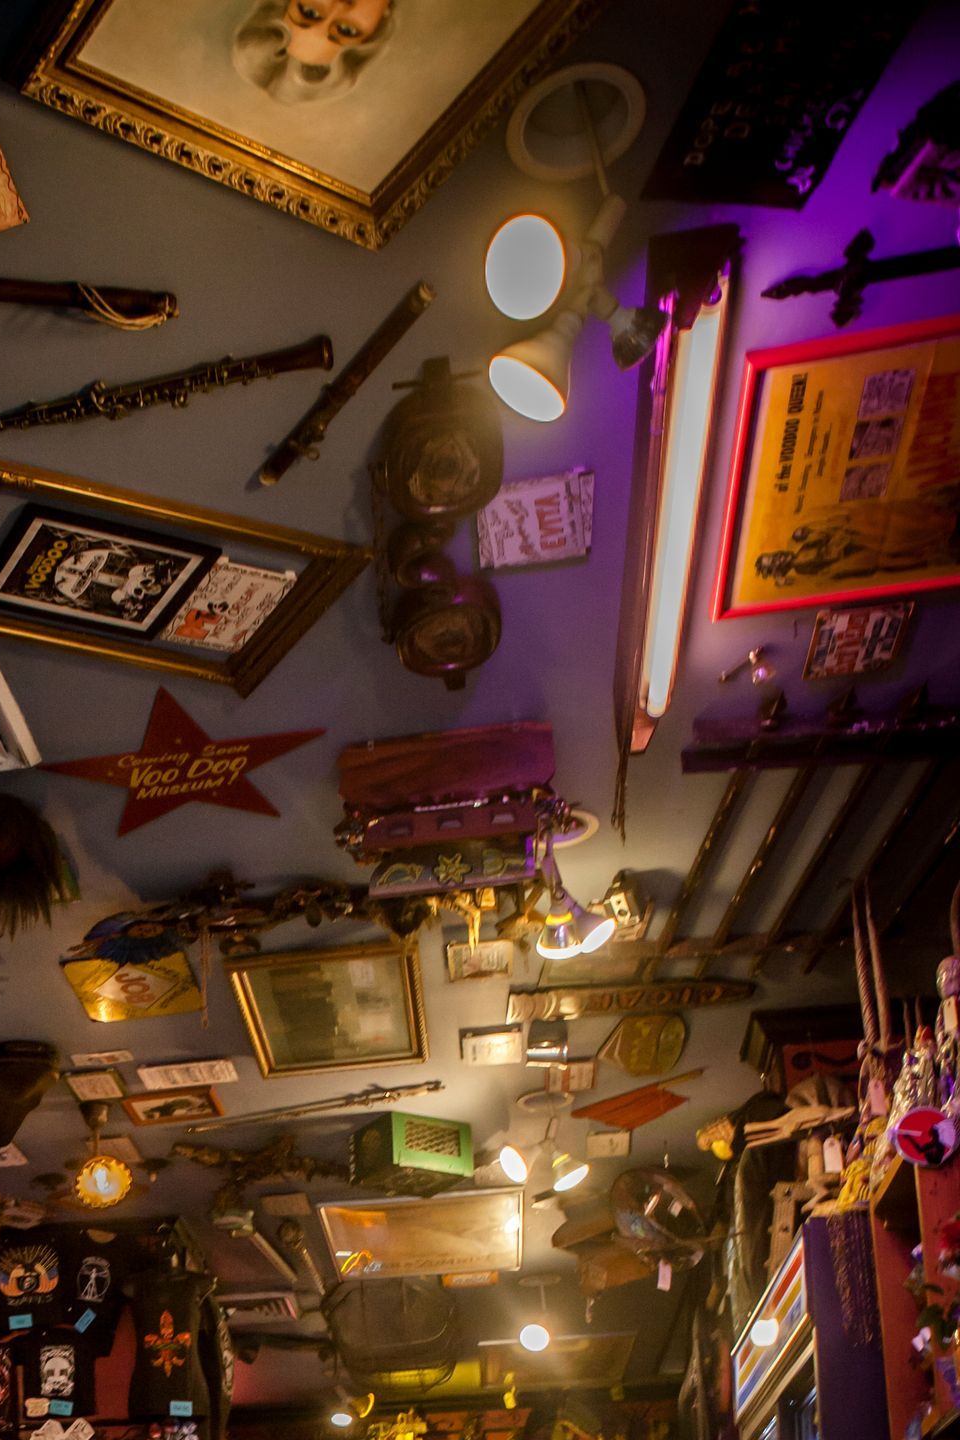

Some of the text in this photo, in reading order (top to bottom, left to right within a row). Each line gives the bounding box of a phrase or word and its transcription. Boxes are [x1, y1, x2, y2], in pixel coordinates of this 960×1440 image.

[779, 417, 800, 464] VOODOO
[24, 539, 68, 591] VOODOO
[117, 744, 250, 768] Coming Soon
[115, 973, 156, 1005] JOB
